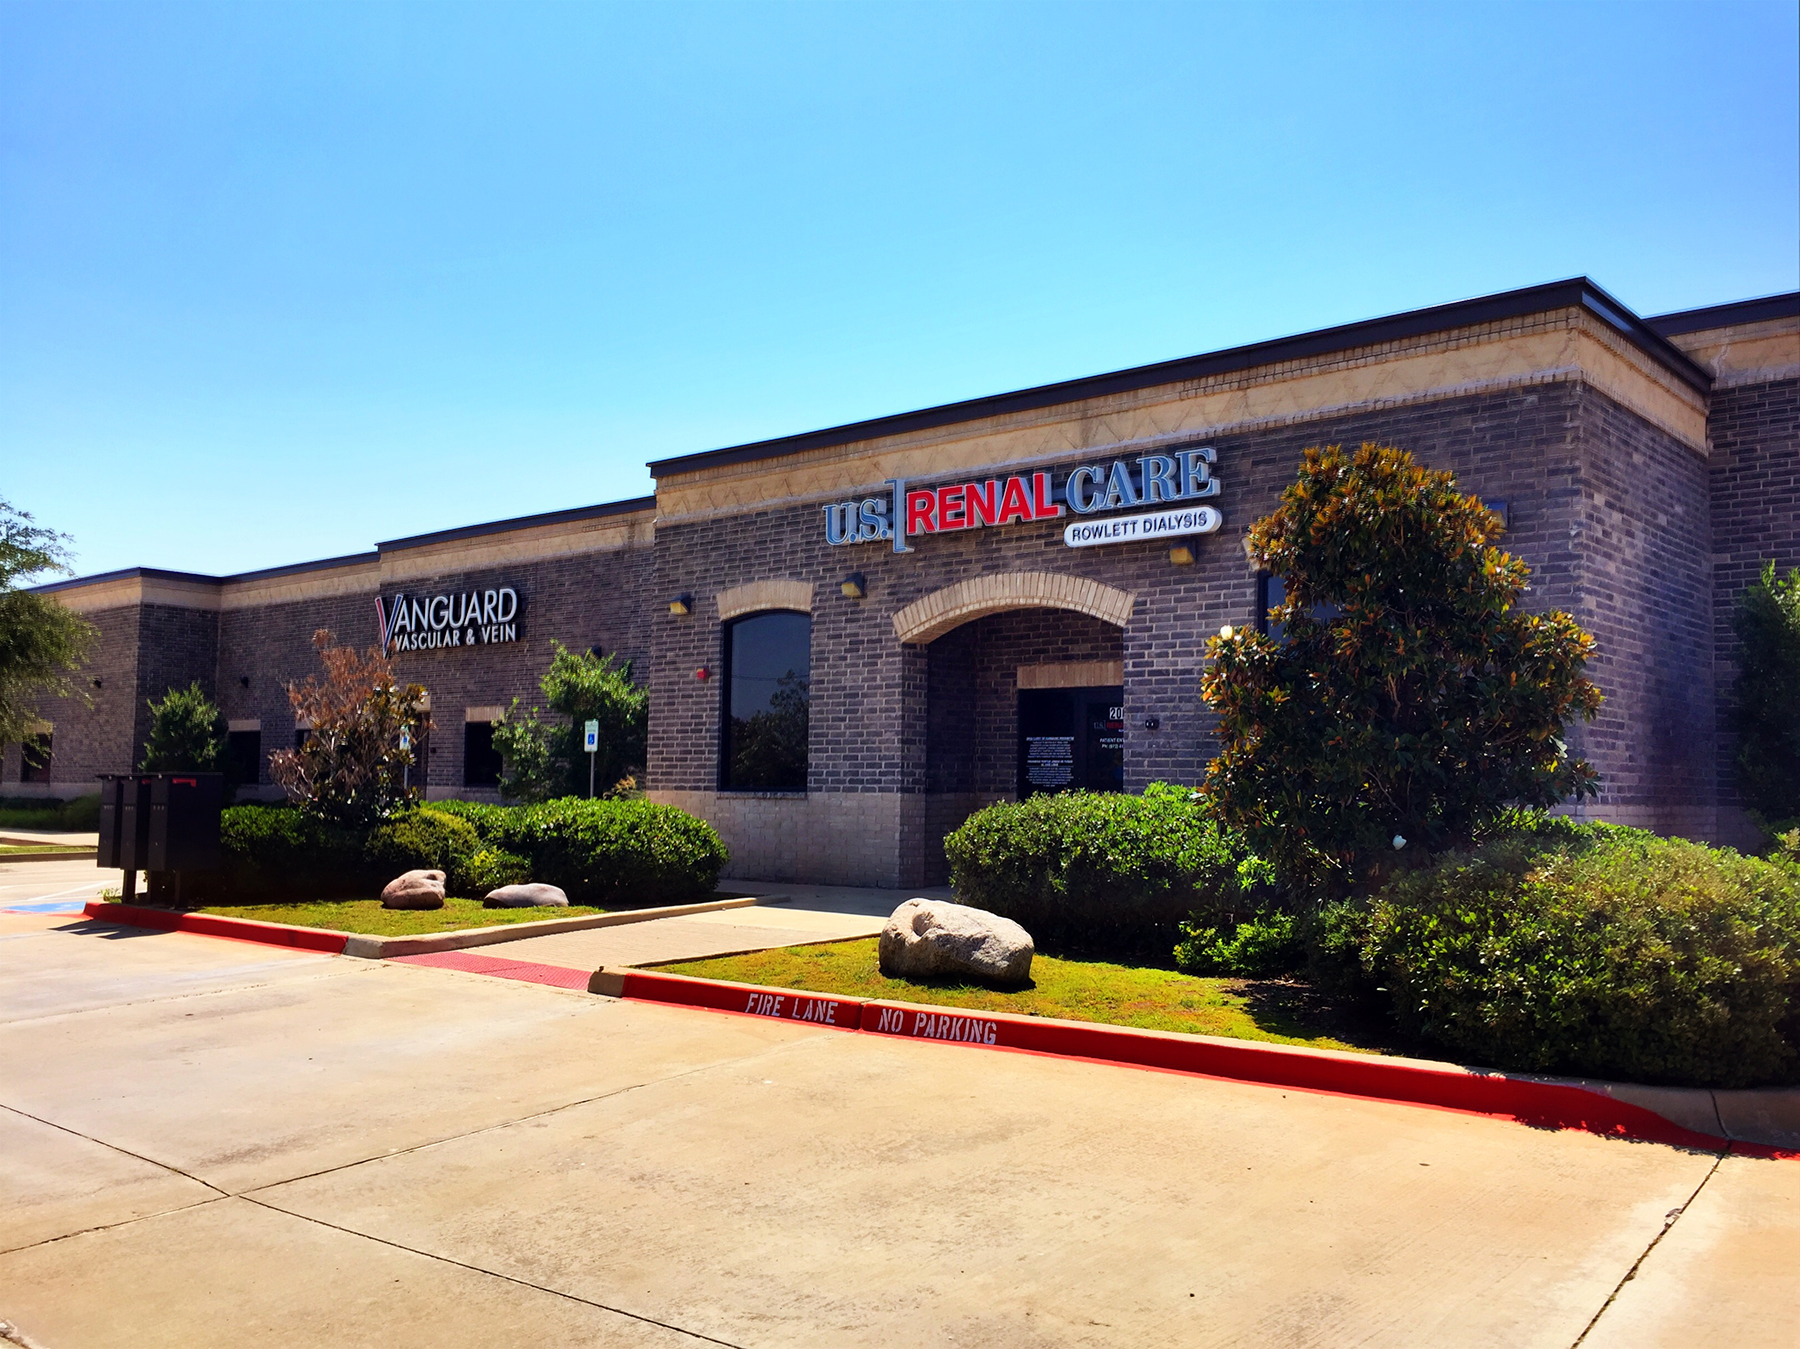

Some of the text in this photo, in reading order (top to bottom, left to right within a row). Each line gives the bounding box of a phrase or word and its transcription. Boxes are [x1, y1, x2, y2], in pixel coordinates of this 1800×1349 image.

[823, 447, 1219, 546] U.S. RENAL CARE
[1072, 510, 1208, 543] ROWLETT DIALYSIS
[375, 587, 518, 660] VANGUARD
[394, 623, 517, 652] VASCULAR & VEIN
[744, 992, 839, 1024] FIRE LANE
[877, 1008, 998, 1045] NO PARKING
